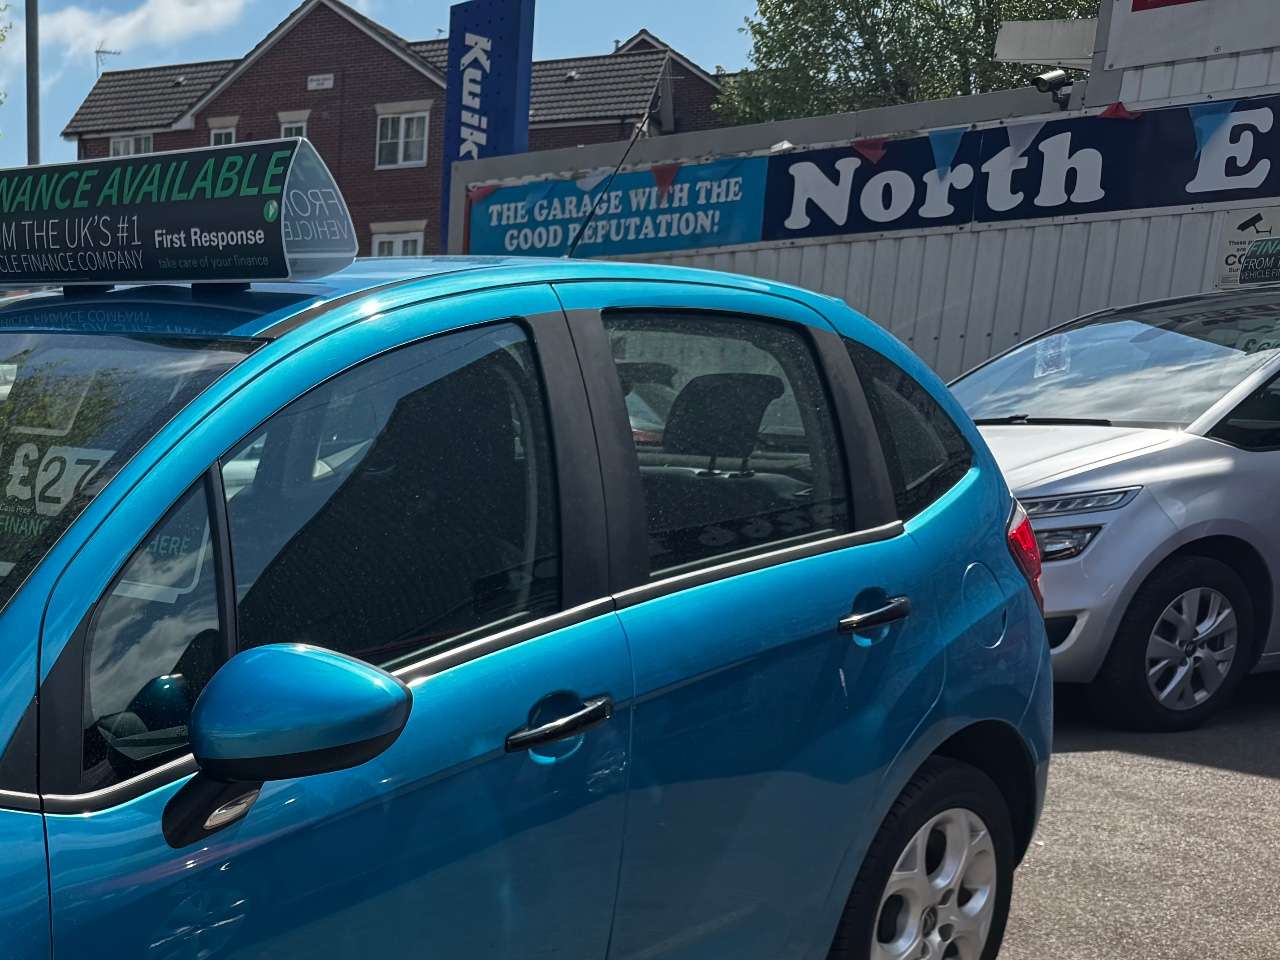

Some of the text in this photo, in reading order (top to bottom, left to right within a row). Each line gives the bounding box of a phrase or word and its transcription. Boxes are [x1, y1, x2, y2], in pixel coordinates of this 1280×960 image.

[460, 33, 492, 160] Kwik
[96, 151, 291, 207] AVAILABLE
[489, 176, 742, 227] THE GARAGE WITH THE
[784, 131, 1105, 230] North
[21, 219, 60, 250] THE
[65, 214, 111, 249] UK'S
[116, 215, 143, 246] #1
[154, 227, 265, 250] First Response
[505, 211, 720, 251] GOOD REPUTATION!
[22, 252, 78, 273] FINANCE
[78, 249, 144, 271] COMPANY
